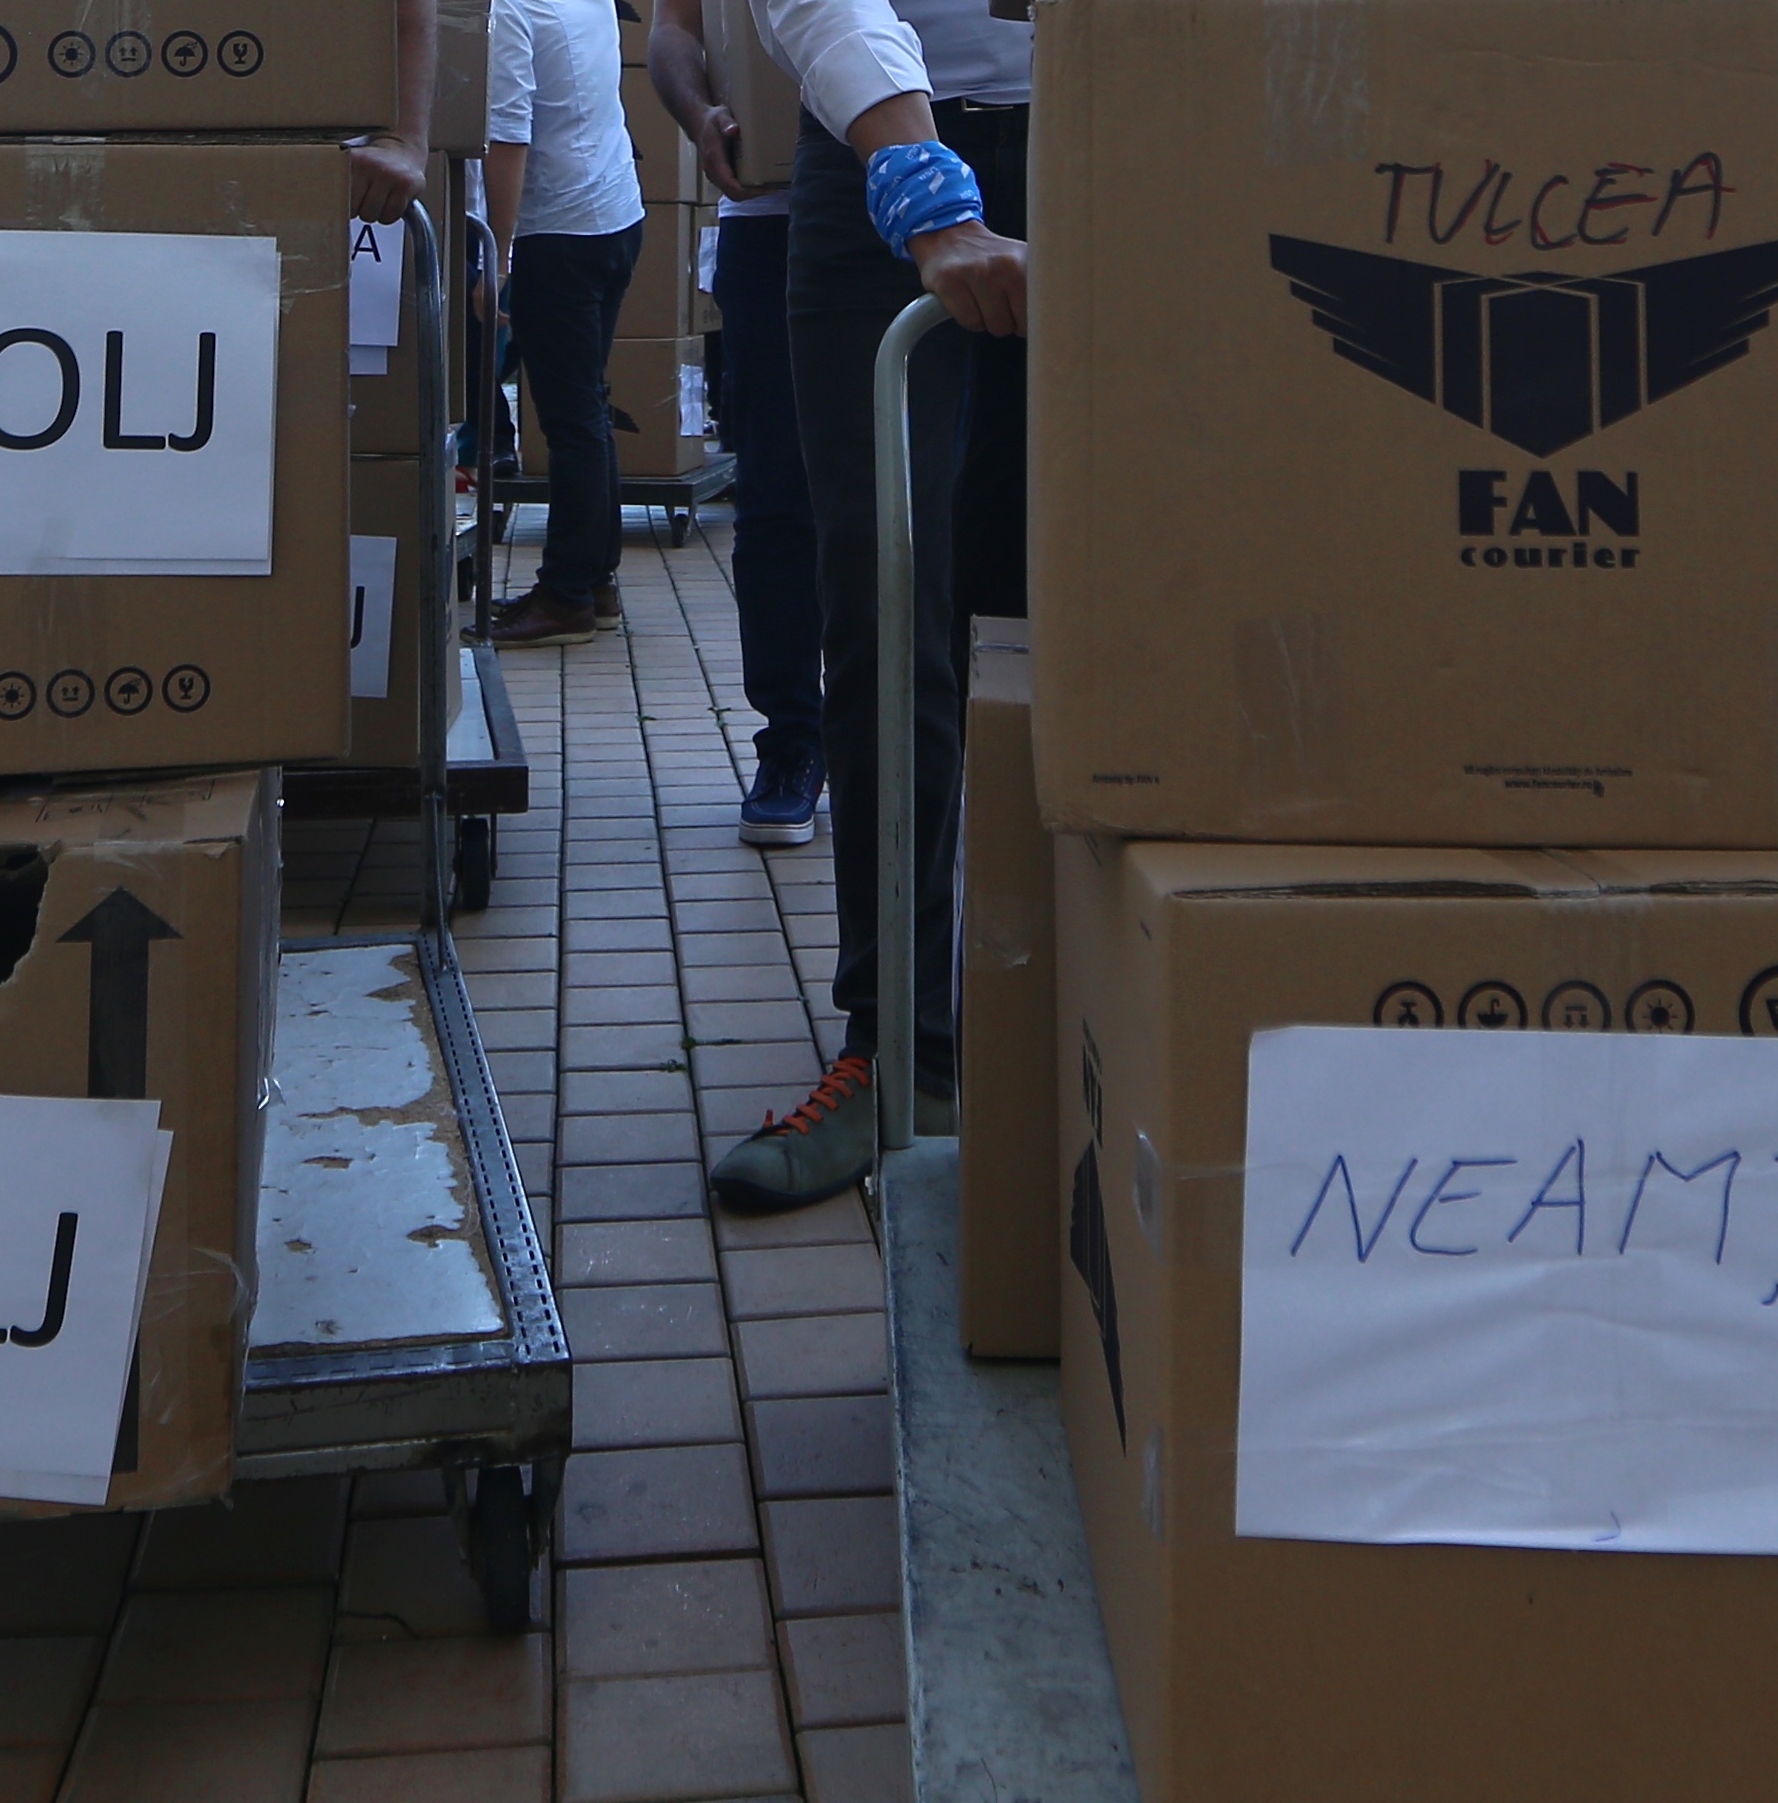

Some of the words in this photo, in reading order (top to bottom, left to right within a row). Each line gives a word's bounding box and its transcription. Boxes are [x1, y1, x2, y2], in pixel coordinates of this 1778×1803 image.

[1374, 150, 1738, 252] TULCEA
[1457, 469, 1640, 538] FAN
[1458, 543, 1642, 570] courier
